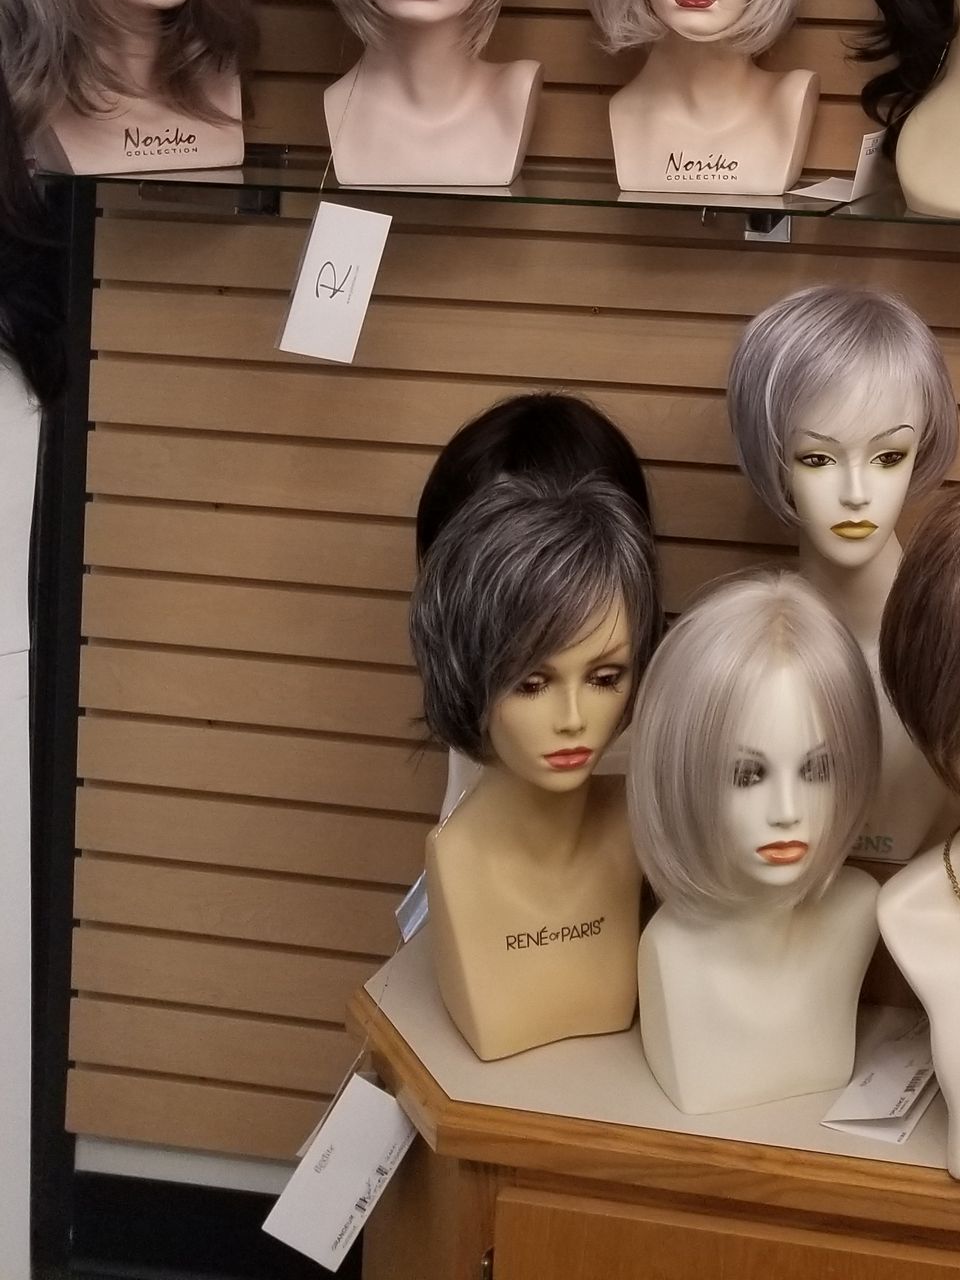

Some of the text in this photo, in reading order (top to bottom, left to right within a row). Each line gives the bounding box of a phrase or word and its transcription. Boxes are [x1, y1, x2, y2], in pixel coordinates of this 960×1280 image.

[124, 126, 197, 150] Noriko
[126, 146, 198, 157] COLLECTION
[665, 151, 738, 174] Noriko
[505, 926, 550, 951] RENÉ
